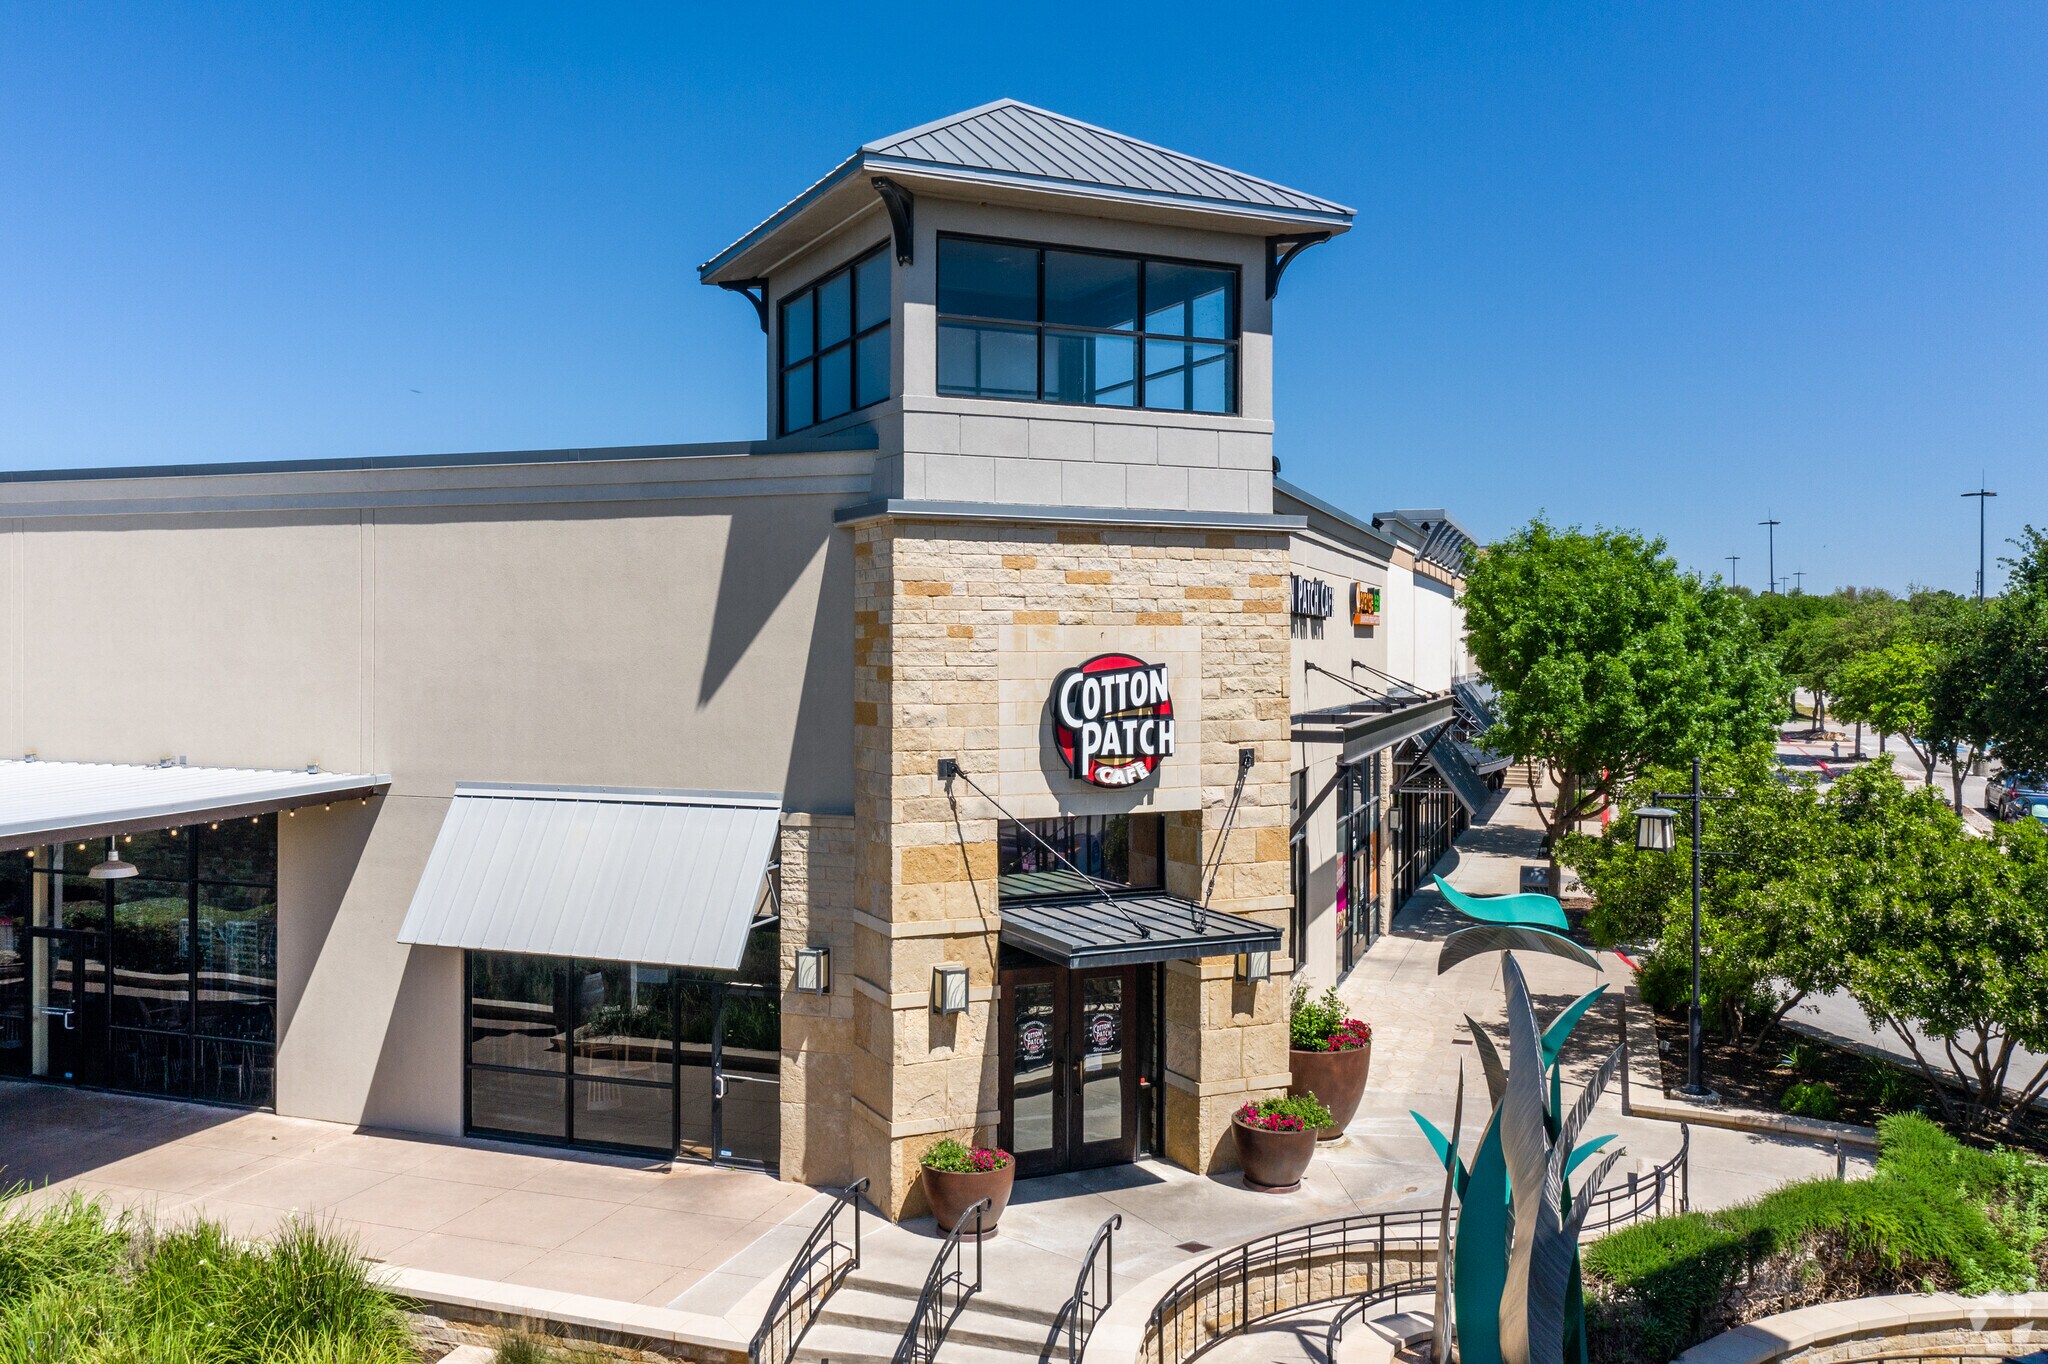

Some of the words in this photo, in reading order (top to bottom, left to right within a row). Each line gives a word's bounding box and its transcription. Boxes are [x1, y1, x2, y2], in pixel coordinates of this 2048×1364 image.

[1298, 576, 1319, 615] PATCH
[1060, 667, 1168, 729] COTTON
[1082, 719, 1175, 776] PATCH
[1094, 761, 1150, 785] CAFE
